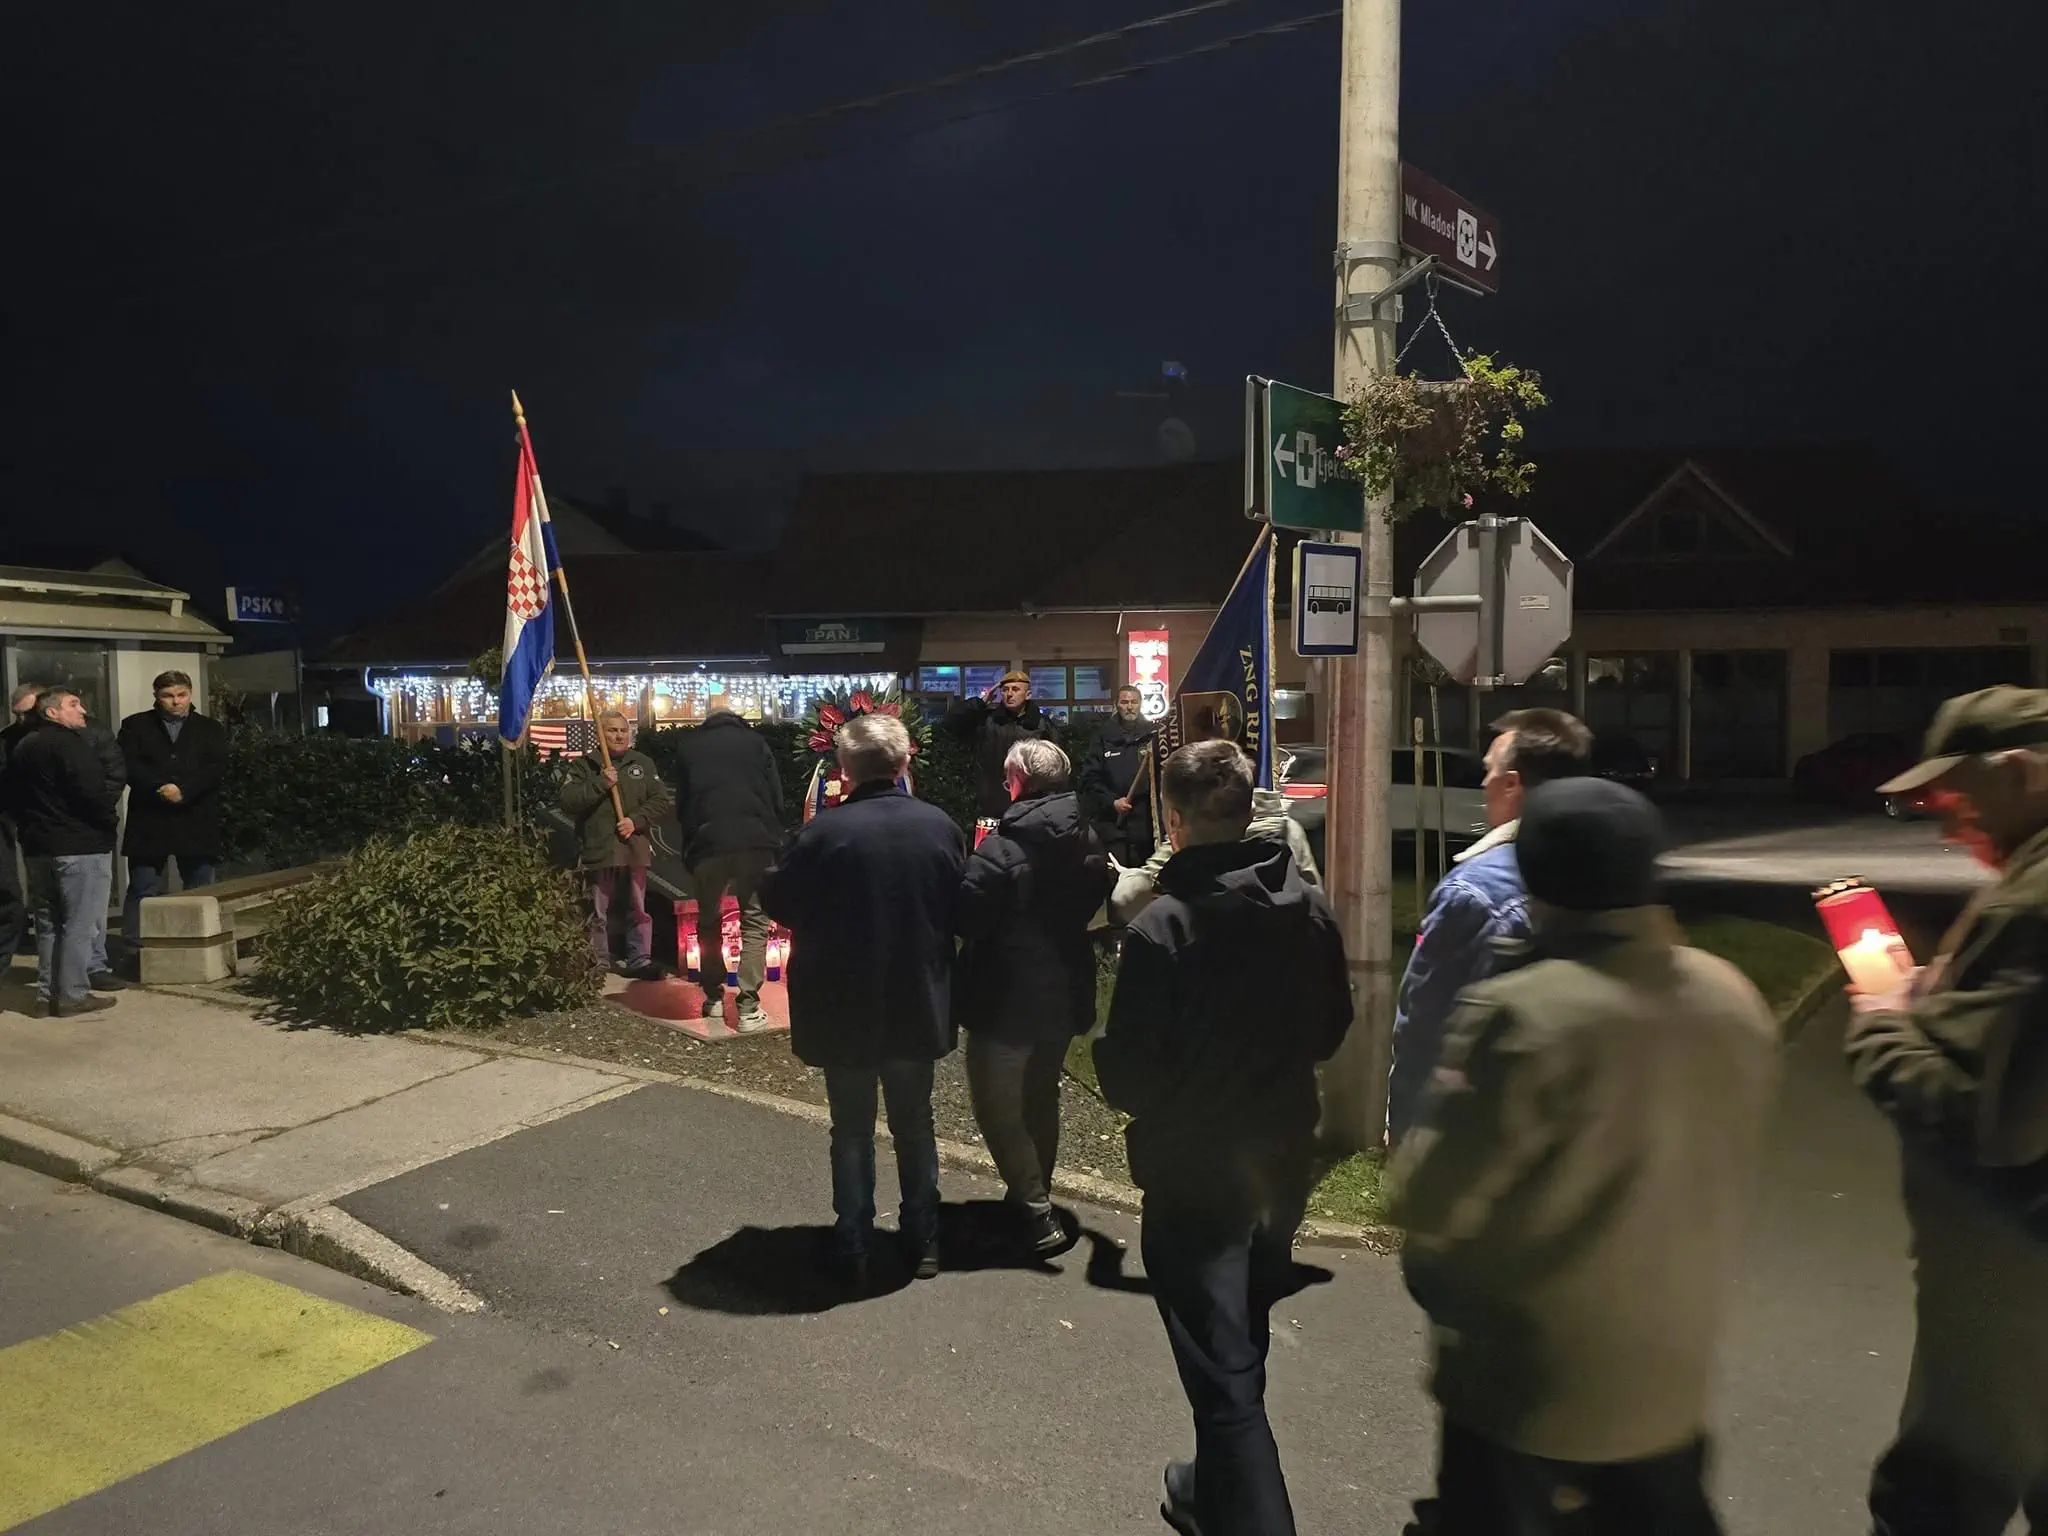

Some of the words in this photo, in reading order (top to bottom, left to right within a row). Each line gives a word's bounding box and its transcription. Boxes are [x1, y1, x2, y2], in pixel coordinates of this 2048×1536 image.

[1405, 193, 1418, 220] NK
[1420, 203, 1456, 241] Mladost
[241, 595, 272, 613] PSK
[814, 630, 850, 641] PAN
[1239, 645, 1258, 703] ZNG
[1246, 709, 1260, 752] RH
